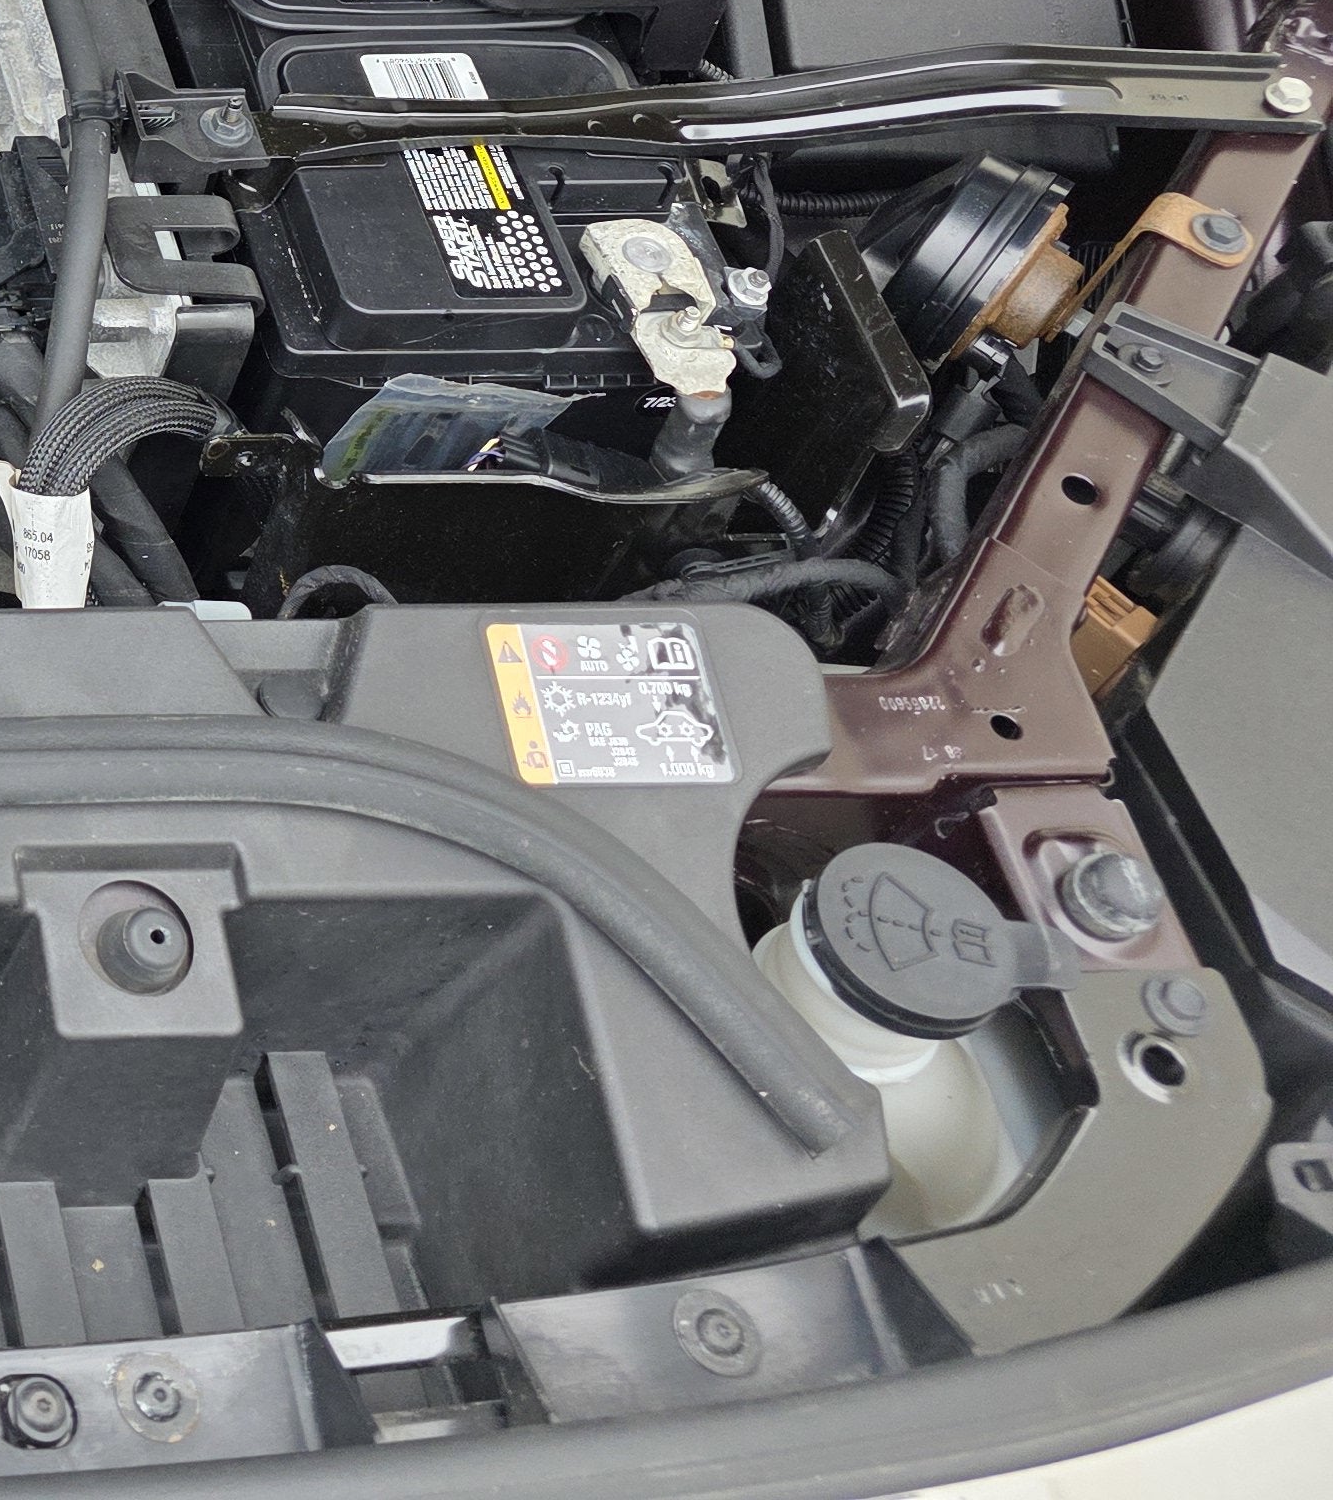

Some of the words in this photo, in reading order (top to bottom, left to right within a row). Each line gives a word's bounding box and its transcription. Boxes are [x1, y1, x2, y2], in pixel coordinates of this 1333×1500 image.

[433, 215, 465, 280] SUPER
[446, 215, 492, 289] START
[580, 660, 609, 672] AUTO
[638, 681, 671, 696] 0.700
[672, 682, 693, 698] kg
[584, 722, 613, 737] PAG
[659, 763, 696, 776] 1.000
[696, 763, 717, 779] kg
